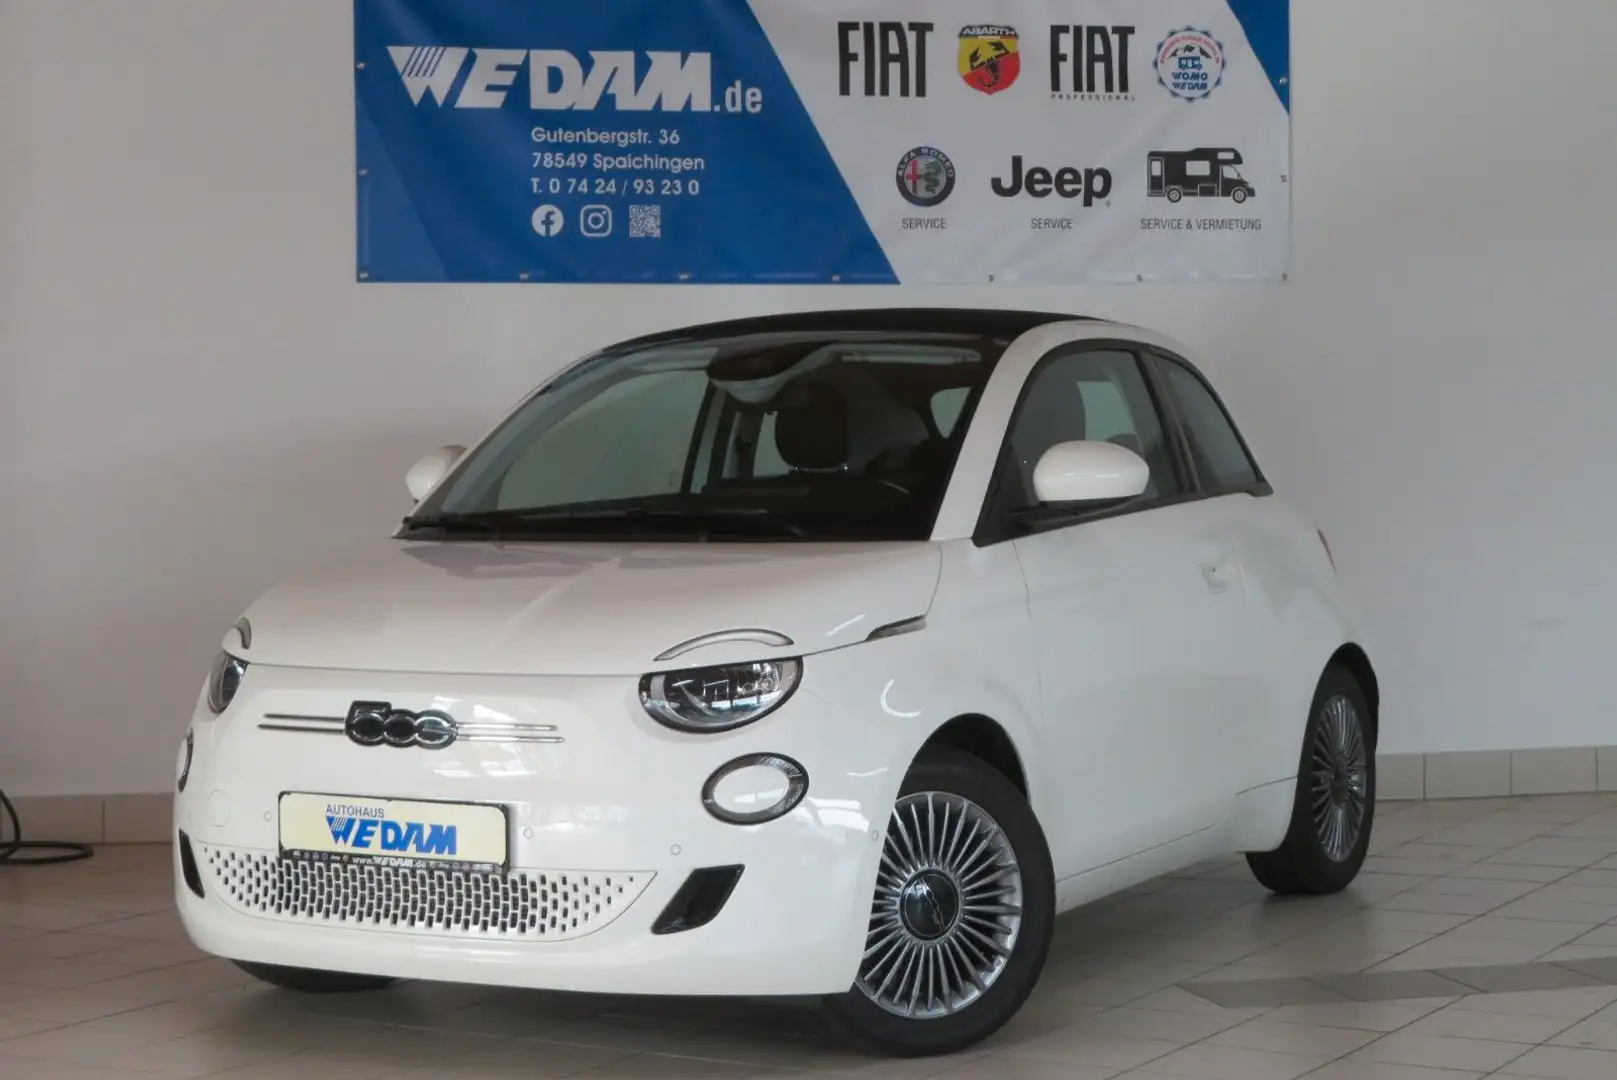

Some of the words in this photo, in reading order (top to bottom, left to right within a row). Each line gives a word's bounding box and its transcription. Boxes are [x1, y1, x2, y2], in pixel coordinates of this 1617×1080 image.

[962, 26, 1015, 36] ABARTH
[837, 21, 934, 98] FIAT
[1050, 25, 1136, 93] FIAT
[531, 127, 652, 148] Gutenbergstr.
[659, 128, 681, 144] 36
[532, 152, 588, 169] 78549
[593, 153, 705, 174] Spaichingen
[530, 177, 543, 194] T.
[549, 178, 561, 194] 0
[567, 178, 589, 194] 74
[595, 178, 617, 195] 24
[633, 179, 655, 195] 93
[661, 179, 683, 195] 23
[688, 179, 700, 195] 0
[990, 155, 1113, 207] Jeep
[901, 217, 947, 230] SERVICE
[1030, 218, 1074, 230] SERVICE
[1140, 218, 1183, 230] SERVICE
[1185, 218, 1193, 230] &
[1196, 218, 1262, 230] VERMIETUNG
[326, 803, 385, 819] AUTOHAUS
[326, 815, 457, 855] WEDAM
